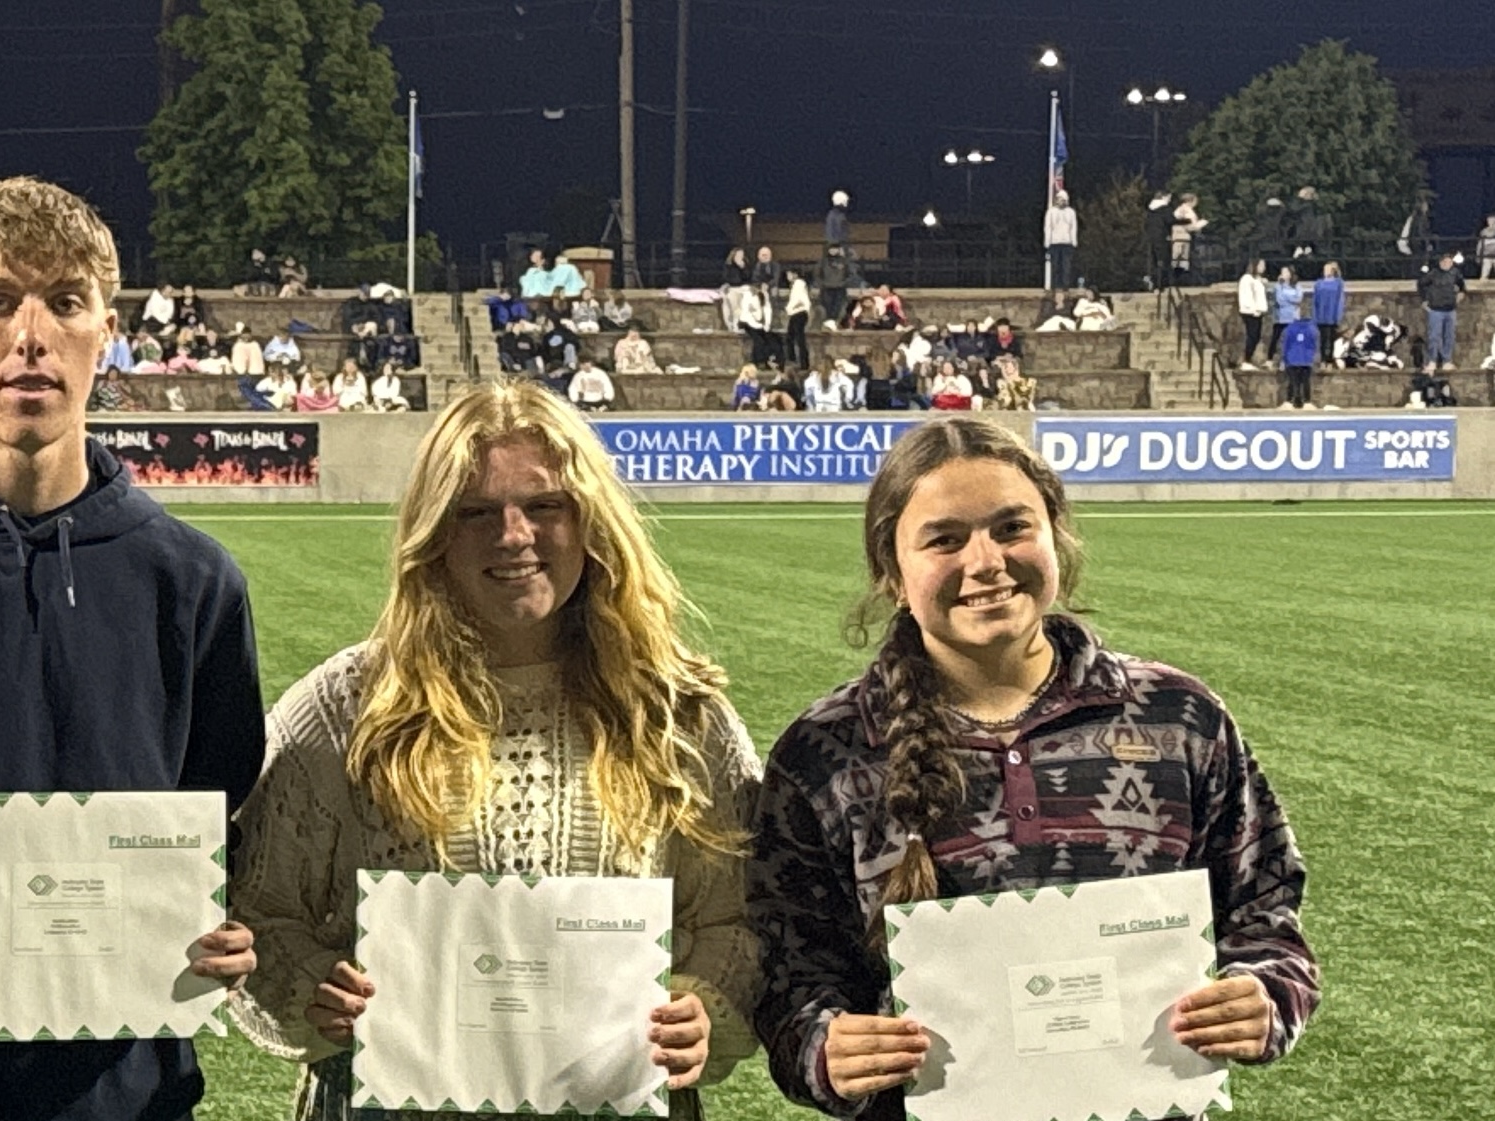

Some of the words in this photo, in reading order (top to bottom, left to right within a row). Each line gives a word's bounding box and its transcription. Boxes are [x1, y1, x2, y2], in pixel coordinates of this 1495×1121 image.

[615, 429, 722, 451] OMAHA
[1364, 430, 1450, 449] SPORTS
[1140, 430, 1356, 471] DUGOUT
[1384, 451, 1429, 468] BAR
[109, 835, 136, 847] First
[140, 835, 173, 846] Class
[176, 834, 200, 847] Mail
[1099, 923, 1125, 934] First
[1130, 920, 1162, 931] Class
[1165, 914, 1189, 927] Mail
